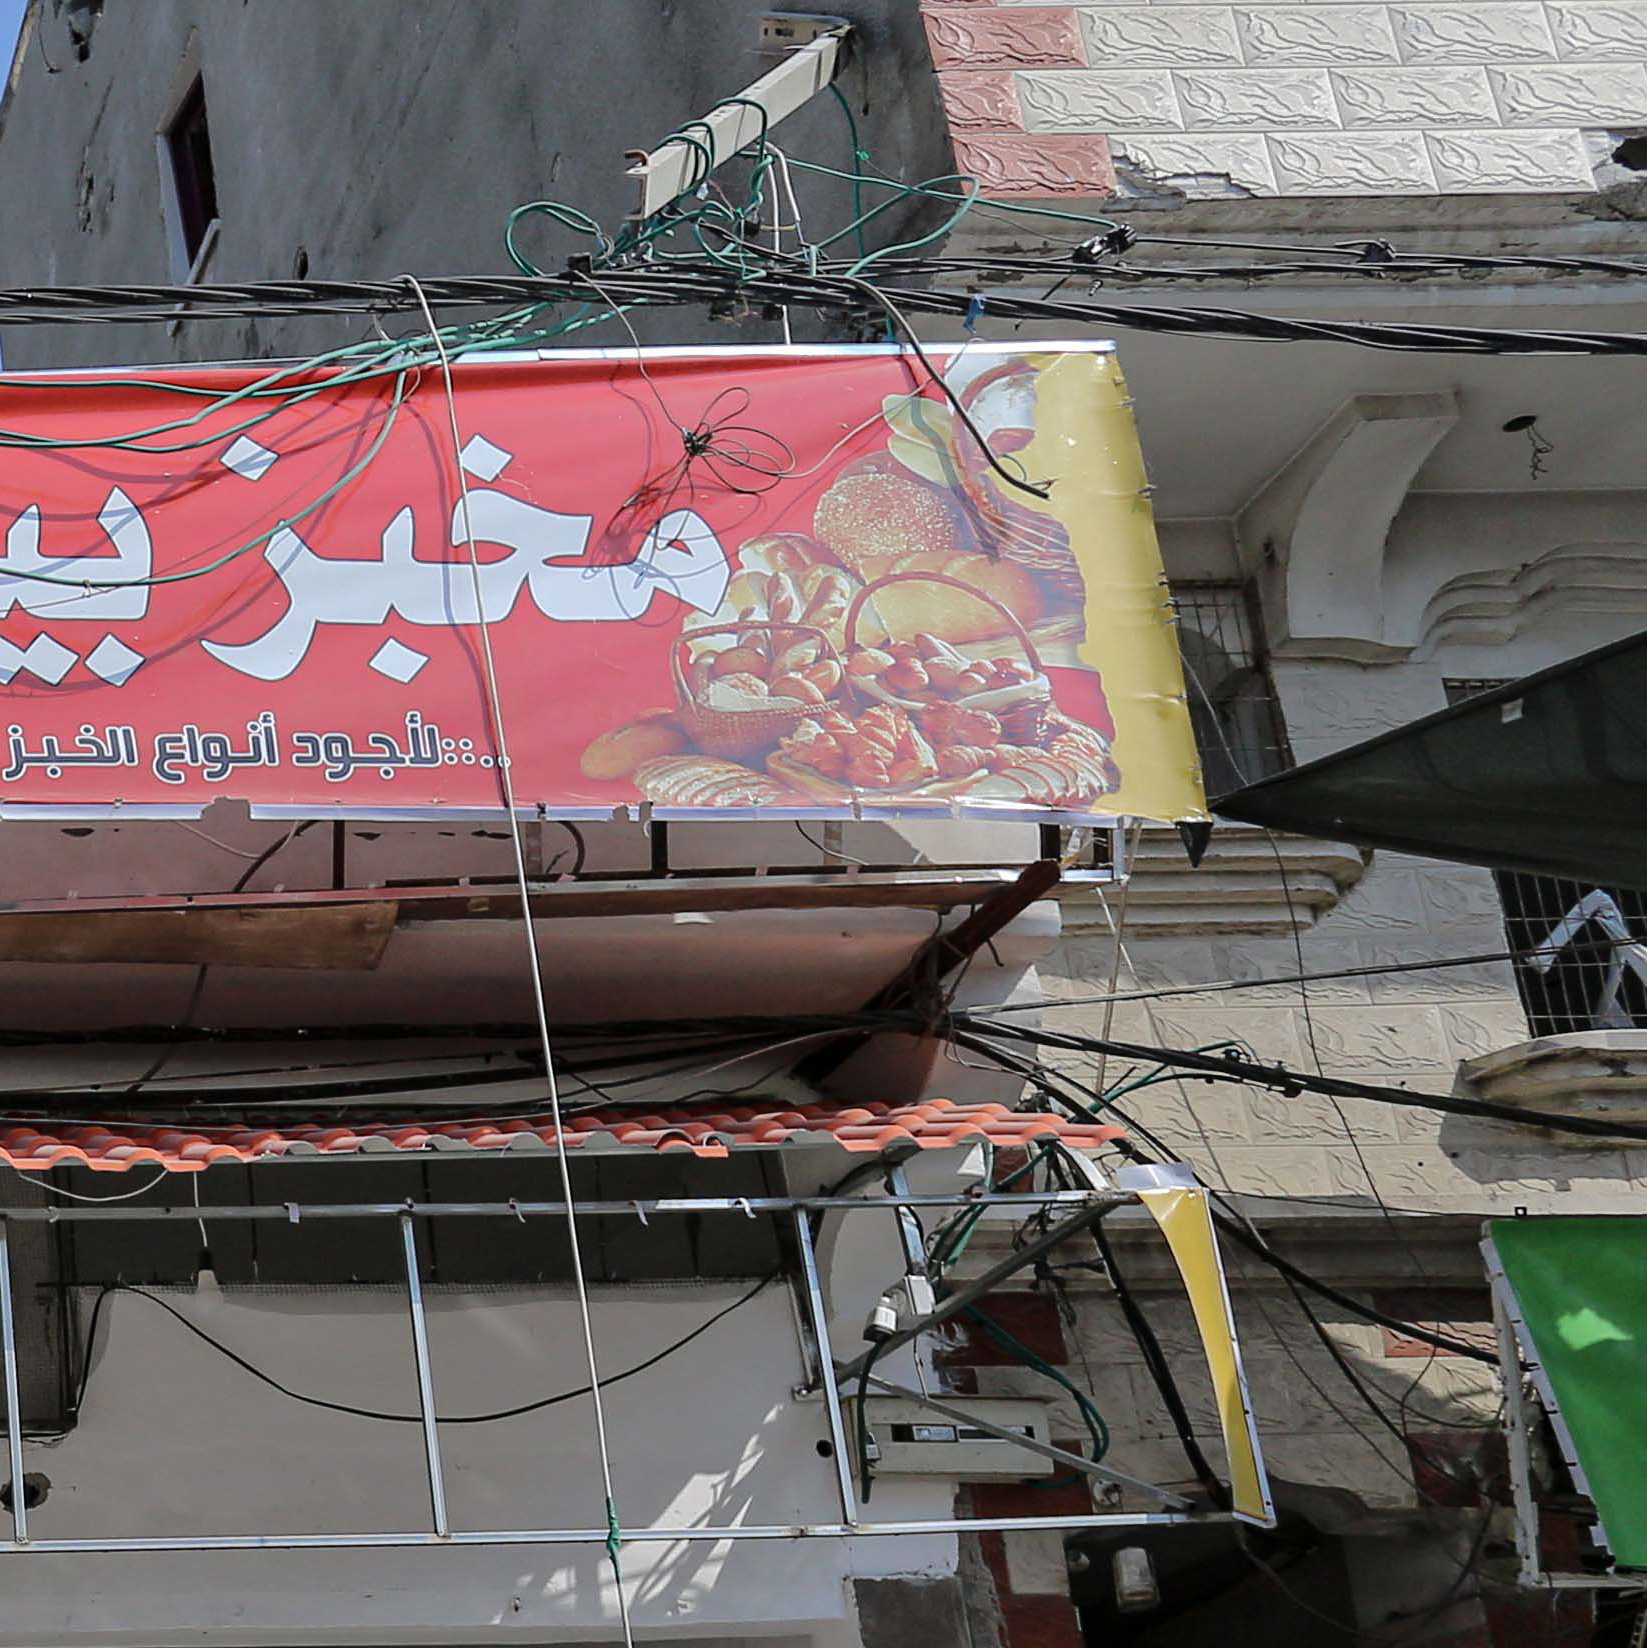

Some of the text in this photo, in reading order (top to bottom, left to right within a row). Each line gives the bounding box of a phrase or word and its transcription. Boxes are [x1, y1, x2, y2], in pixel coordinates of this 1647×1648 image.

[200, 433, 732, 683] مخبز
[1, 720, 136, 781] الخبز
[152, 711, 280, 782] أنواع
